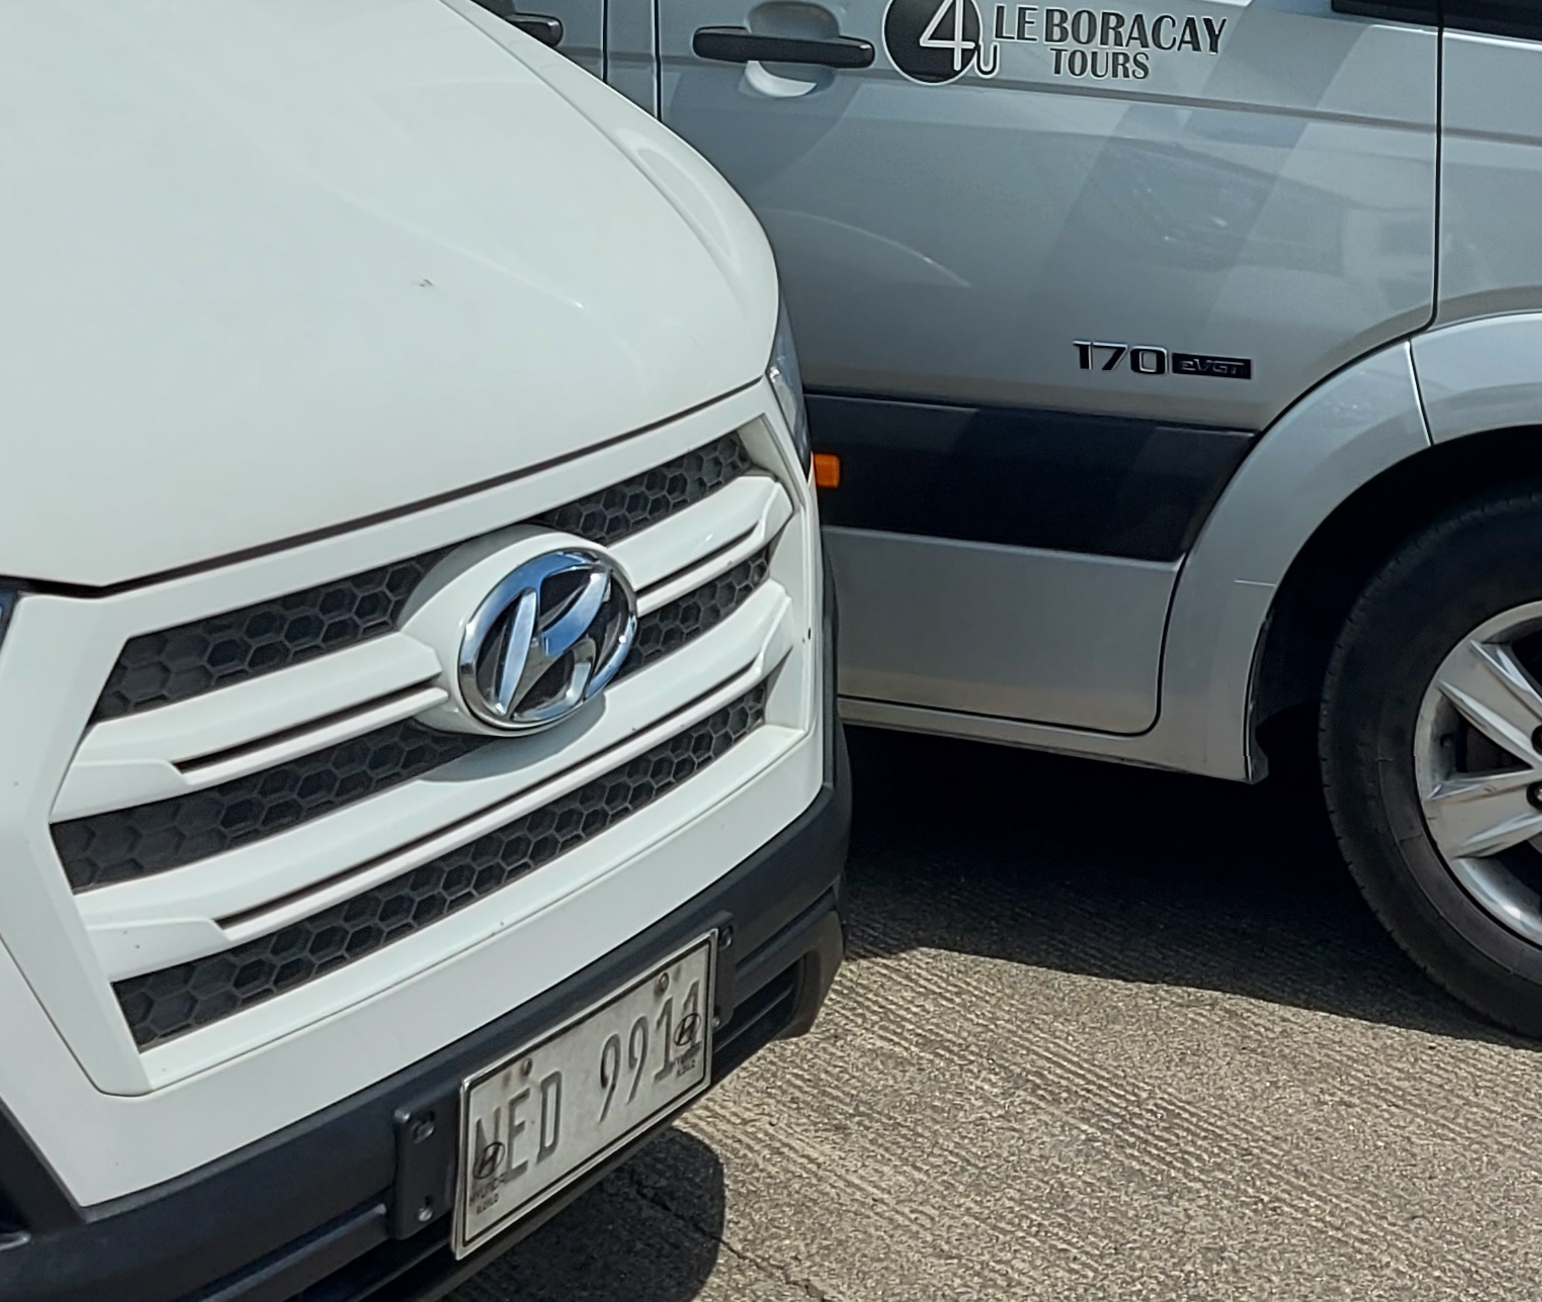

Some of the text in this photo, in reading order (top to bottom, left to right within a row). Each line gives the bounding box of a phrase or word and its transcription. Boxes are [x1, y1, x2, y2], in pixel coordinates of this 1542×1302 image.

[995, 5, 1038, 41] LE
[1044, 8, 1227, 53] BORACAY
[1050, 48, 1149, 80] TOURS
[1073, 340, 1168, 375] 170
